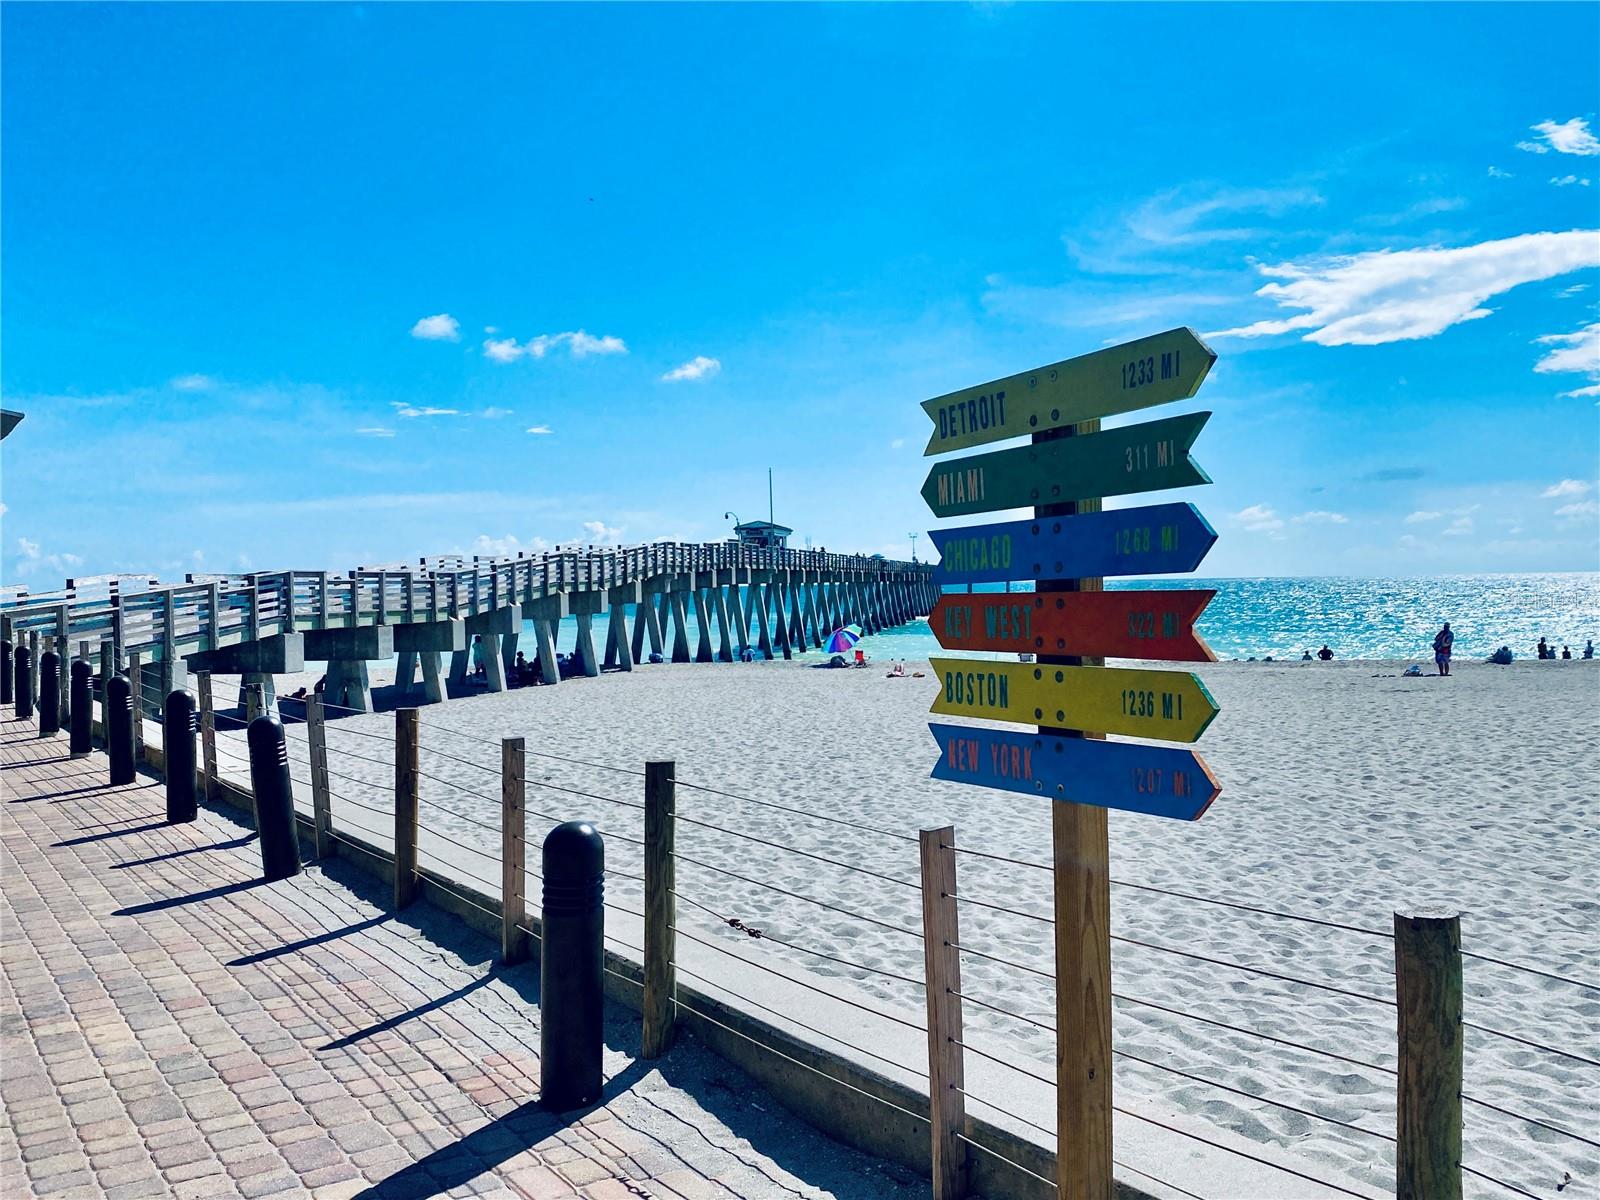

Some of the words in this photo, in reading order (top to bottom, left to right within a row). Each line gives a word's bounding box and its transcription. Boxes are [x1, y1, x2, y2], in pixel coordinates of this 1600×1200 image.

[939, 391, 1005, 439] DETROIT
[1121, 356, 1154, 389] 1233
[1161, 350, 1180, 379] MI
[938, 467, 984, 506] MIAMI
[1125, 446, 1149, 472] 311
[1157, 439, 1174, 467] MI
[945, 534, 1011, 572] CHICAGO
[1116, 527, 1150, 554] 1268
[1161, 525, 1179, 552] MI
[945, 606, 972, 637] KEY
[984, 605, 1032, 639] WEST
[1162, 612, 1181, 639] MI
[946, 672, 1008, 708] BOSTON
[1121, 689, 1154, 717] 1236
[1162, 693, 1182, 720] MI
[948, 738, 979, 772] NEW
[991, 743, 1032, 780] YORK
[1173, 770, 1192, 798] MI
